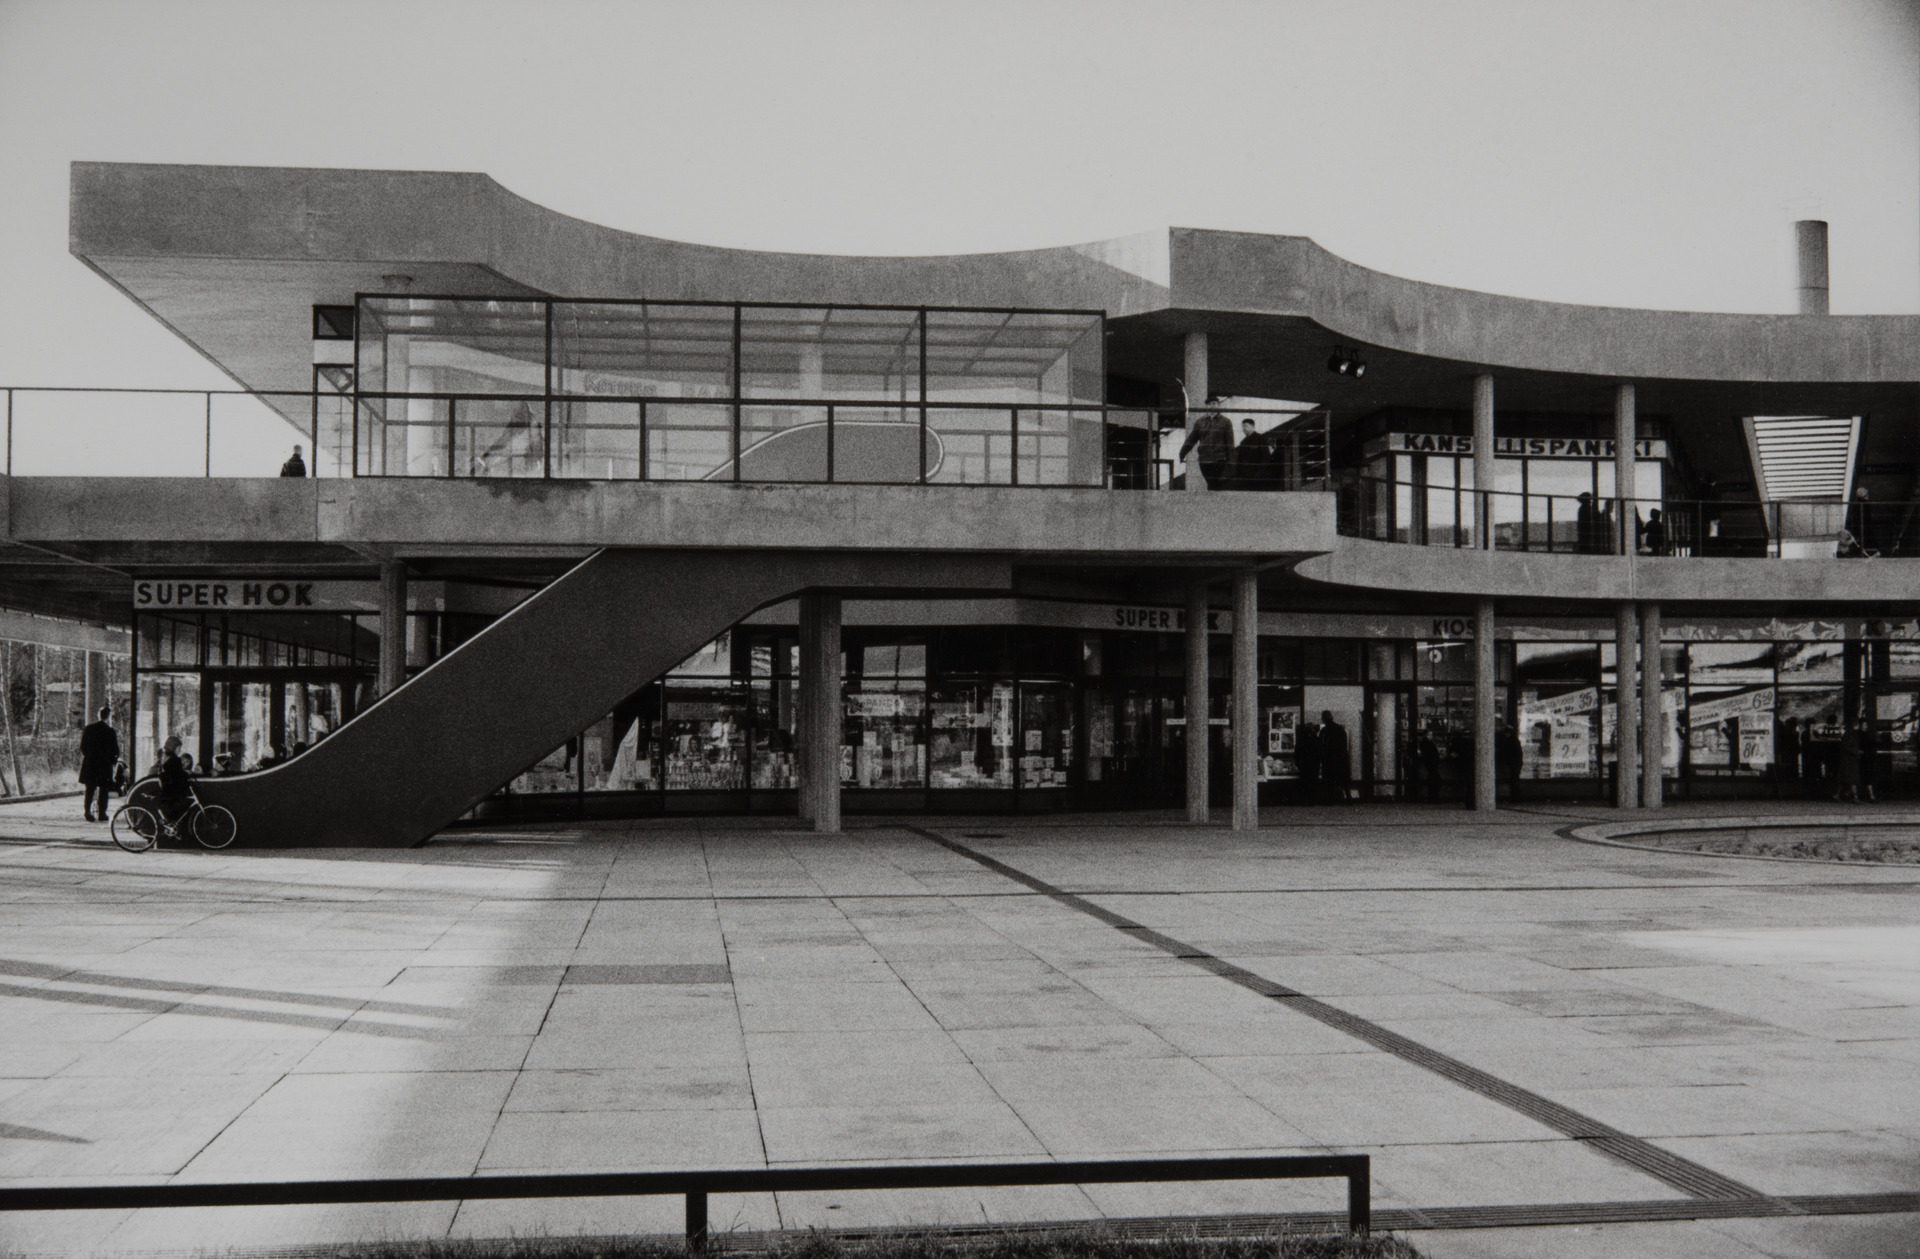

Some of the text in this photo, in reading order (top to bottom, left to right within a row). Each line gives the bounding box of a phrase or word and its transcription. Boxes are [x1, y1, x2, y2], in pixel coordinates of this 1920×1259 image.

[1404, 433, 1651, 456] KANSLLISPANKI
[137, 582, 314, 607] SUPER HOK
[1116, 607, 1219, 631] SUPER HK
[1433, 618, 1476, 636] KIOS
